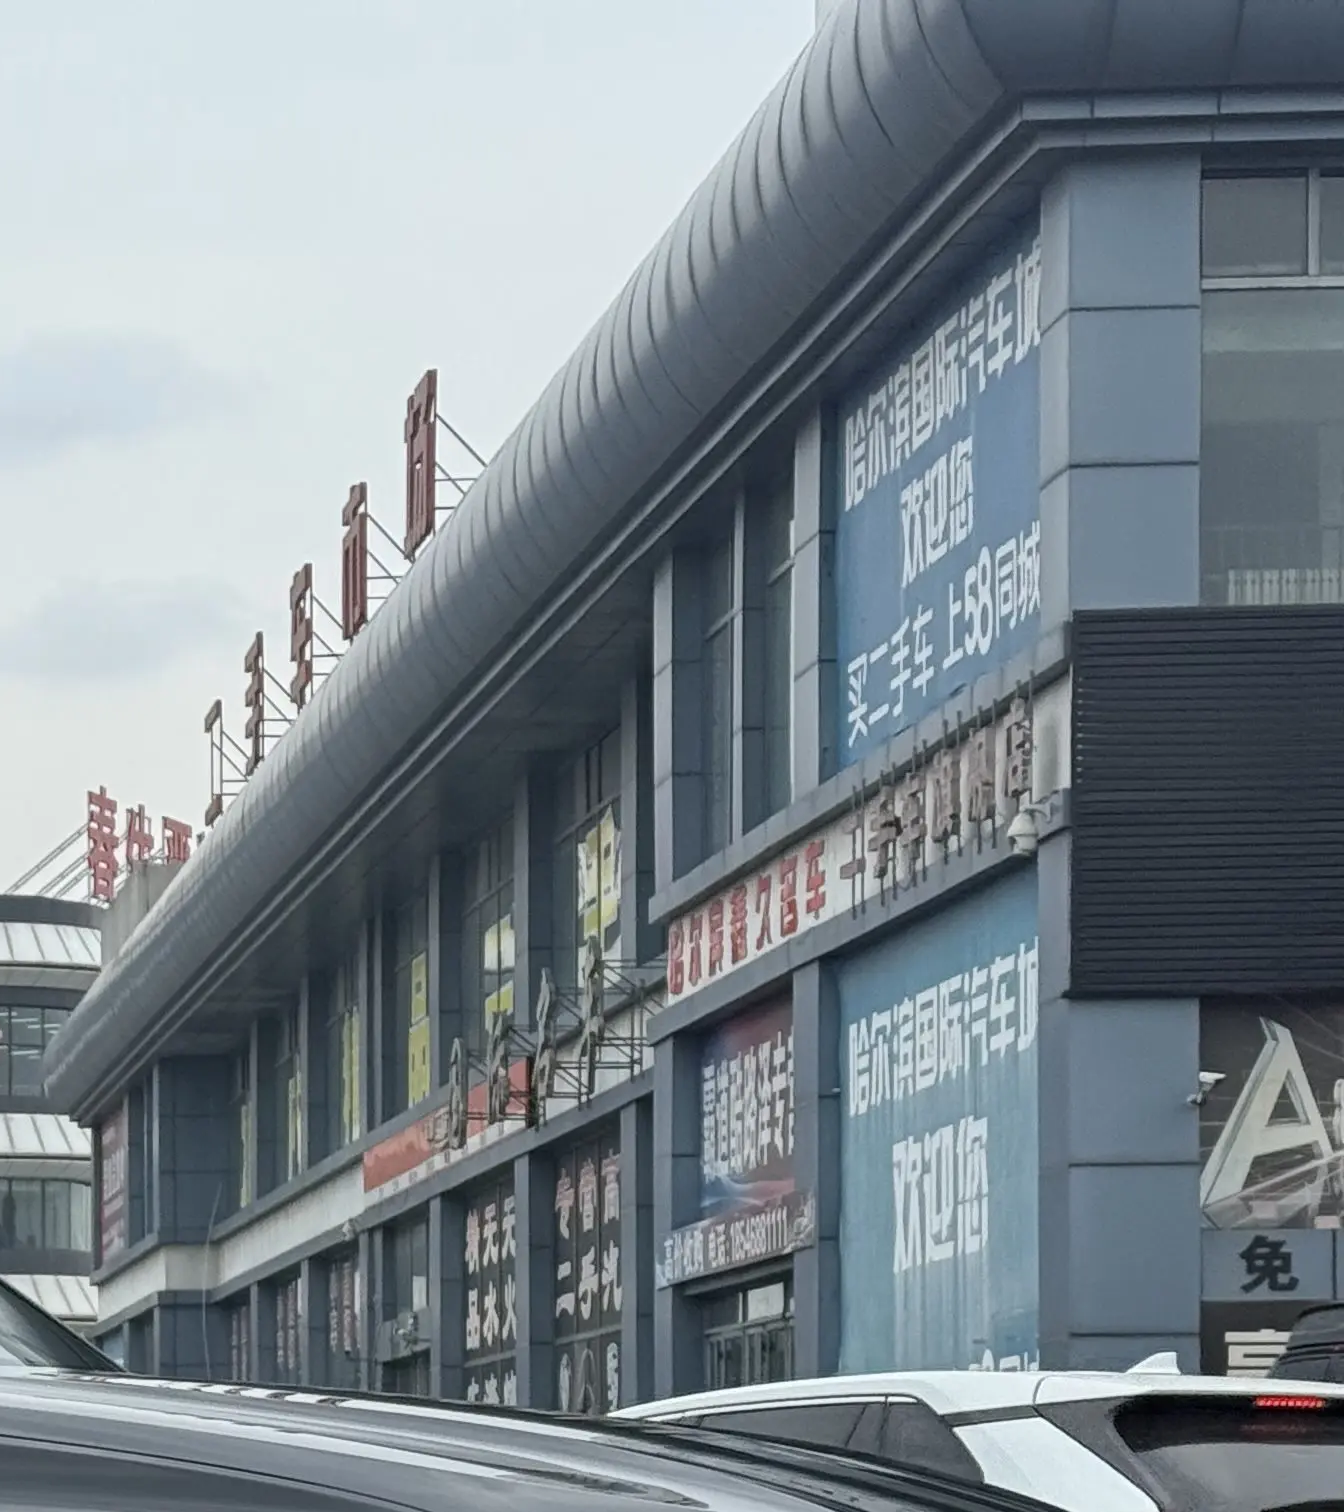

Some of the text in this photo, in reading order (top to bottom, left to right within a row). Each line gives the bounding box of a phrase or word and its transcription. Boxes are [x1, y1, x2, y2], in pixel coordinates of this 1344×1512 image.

[844, 237, 1042, 512] 哈尔滨国际汽车城
[900, 435, 973, 590] 欢迎您
[847, 522, 1040, 747] 买二手车 上58同城
[893, 1114, 989, 1274] 欢迎您
[1240, 1235, 1299, 1293] 免
